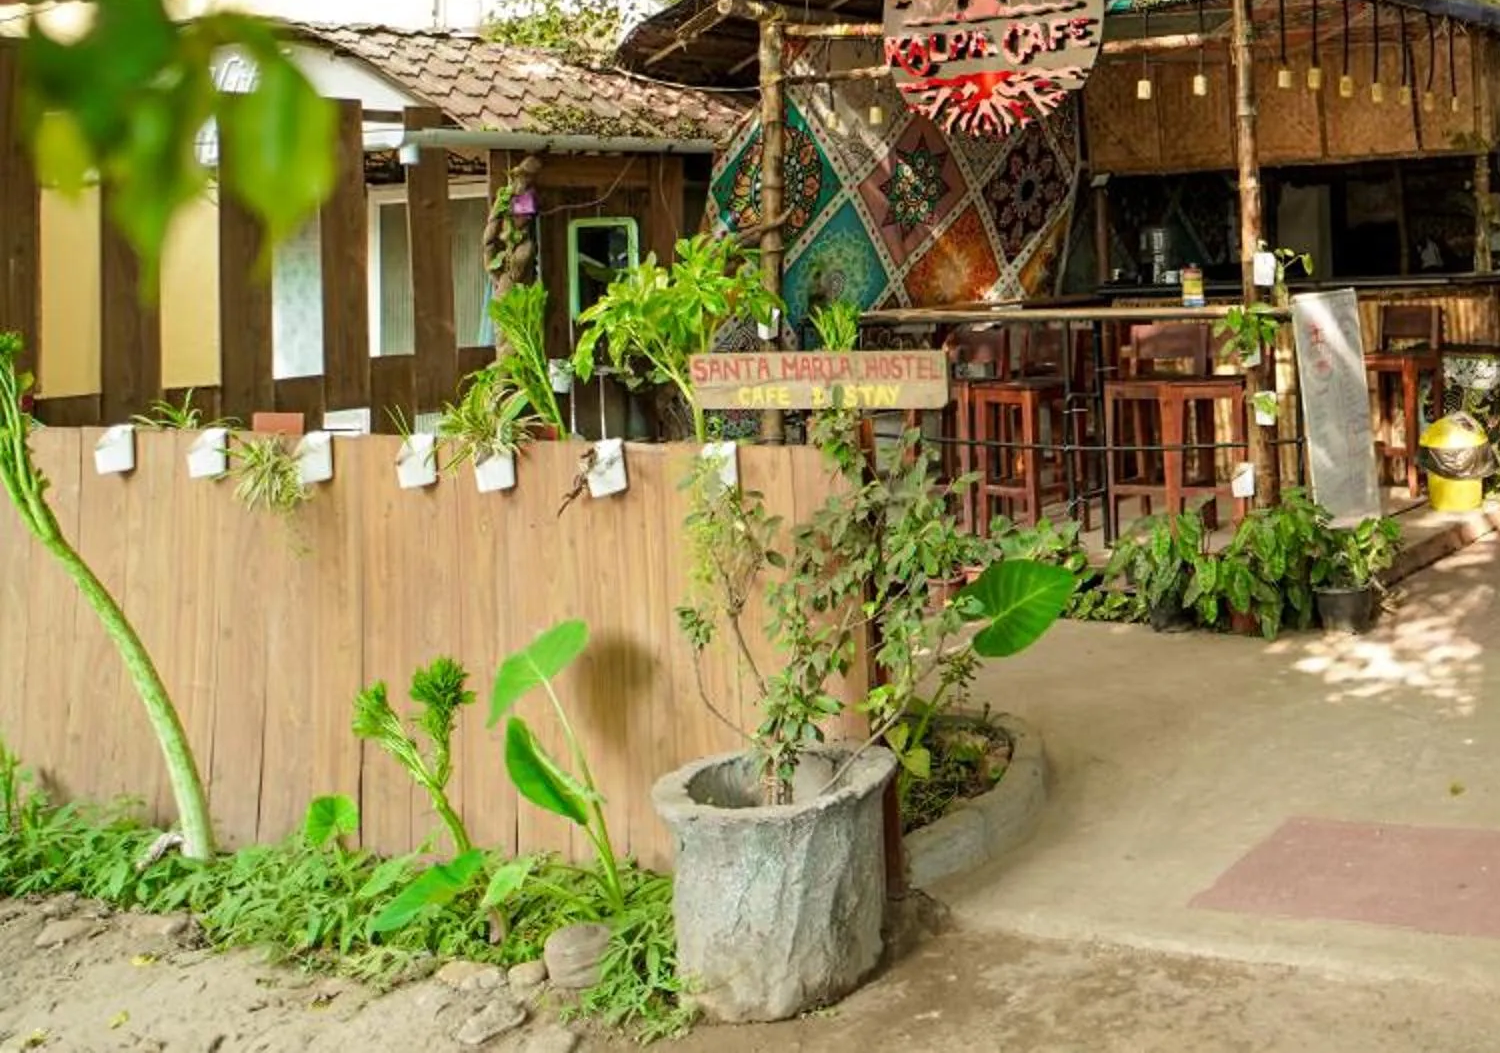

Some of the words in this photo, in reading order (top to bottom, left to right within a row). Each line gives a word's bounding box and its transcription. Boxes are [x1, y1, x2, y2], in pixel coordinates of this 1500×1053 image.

[885, 27, 999, 76] KALPA
[1003, 18, 1097, 65] CAFE
[692, 355, 769, 381] SANTA
[782, 354, 852, 383] MARIA
[865, 354, 940, 380] HOSTEL
[737, 387, 792, 406] CAFE
[843, 385, 900, 406] STAY
